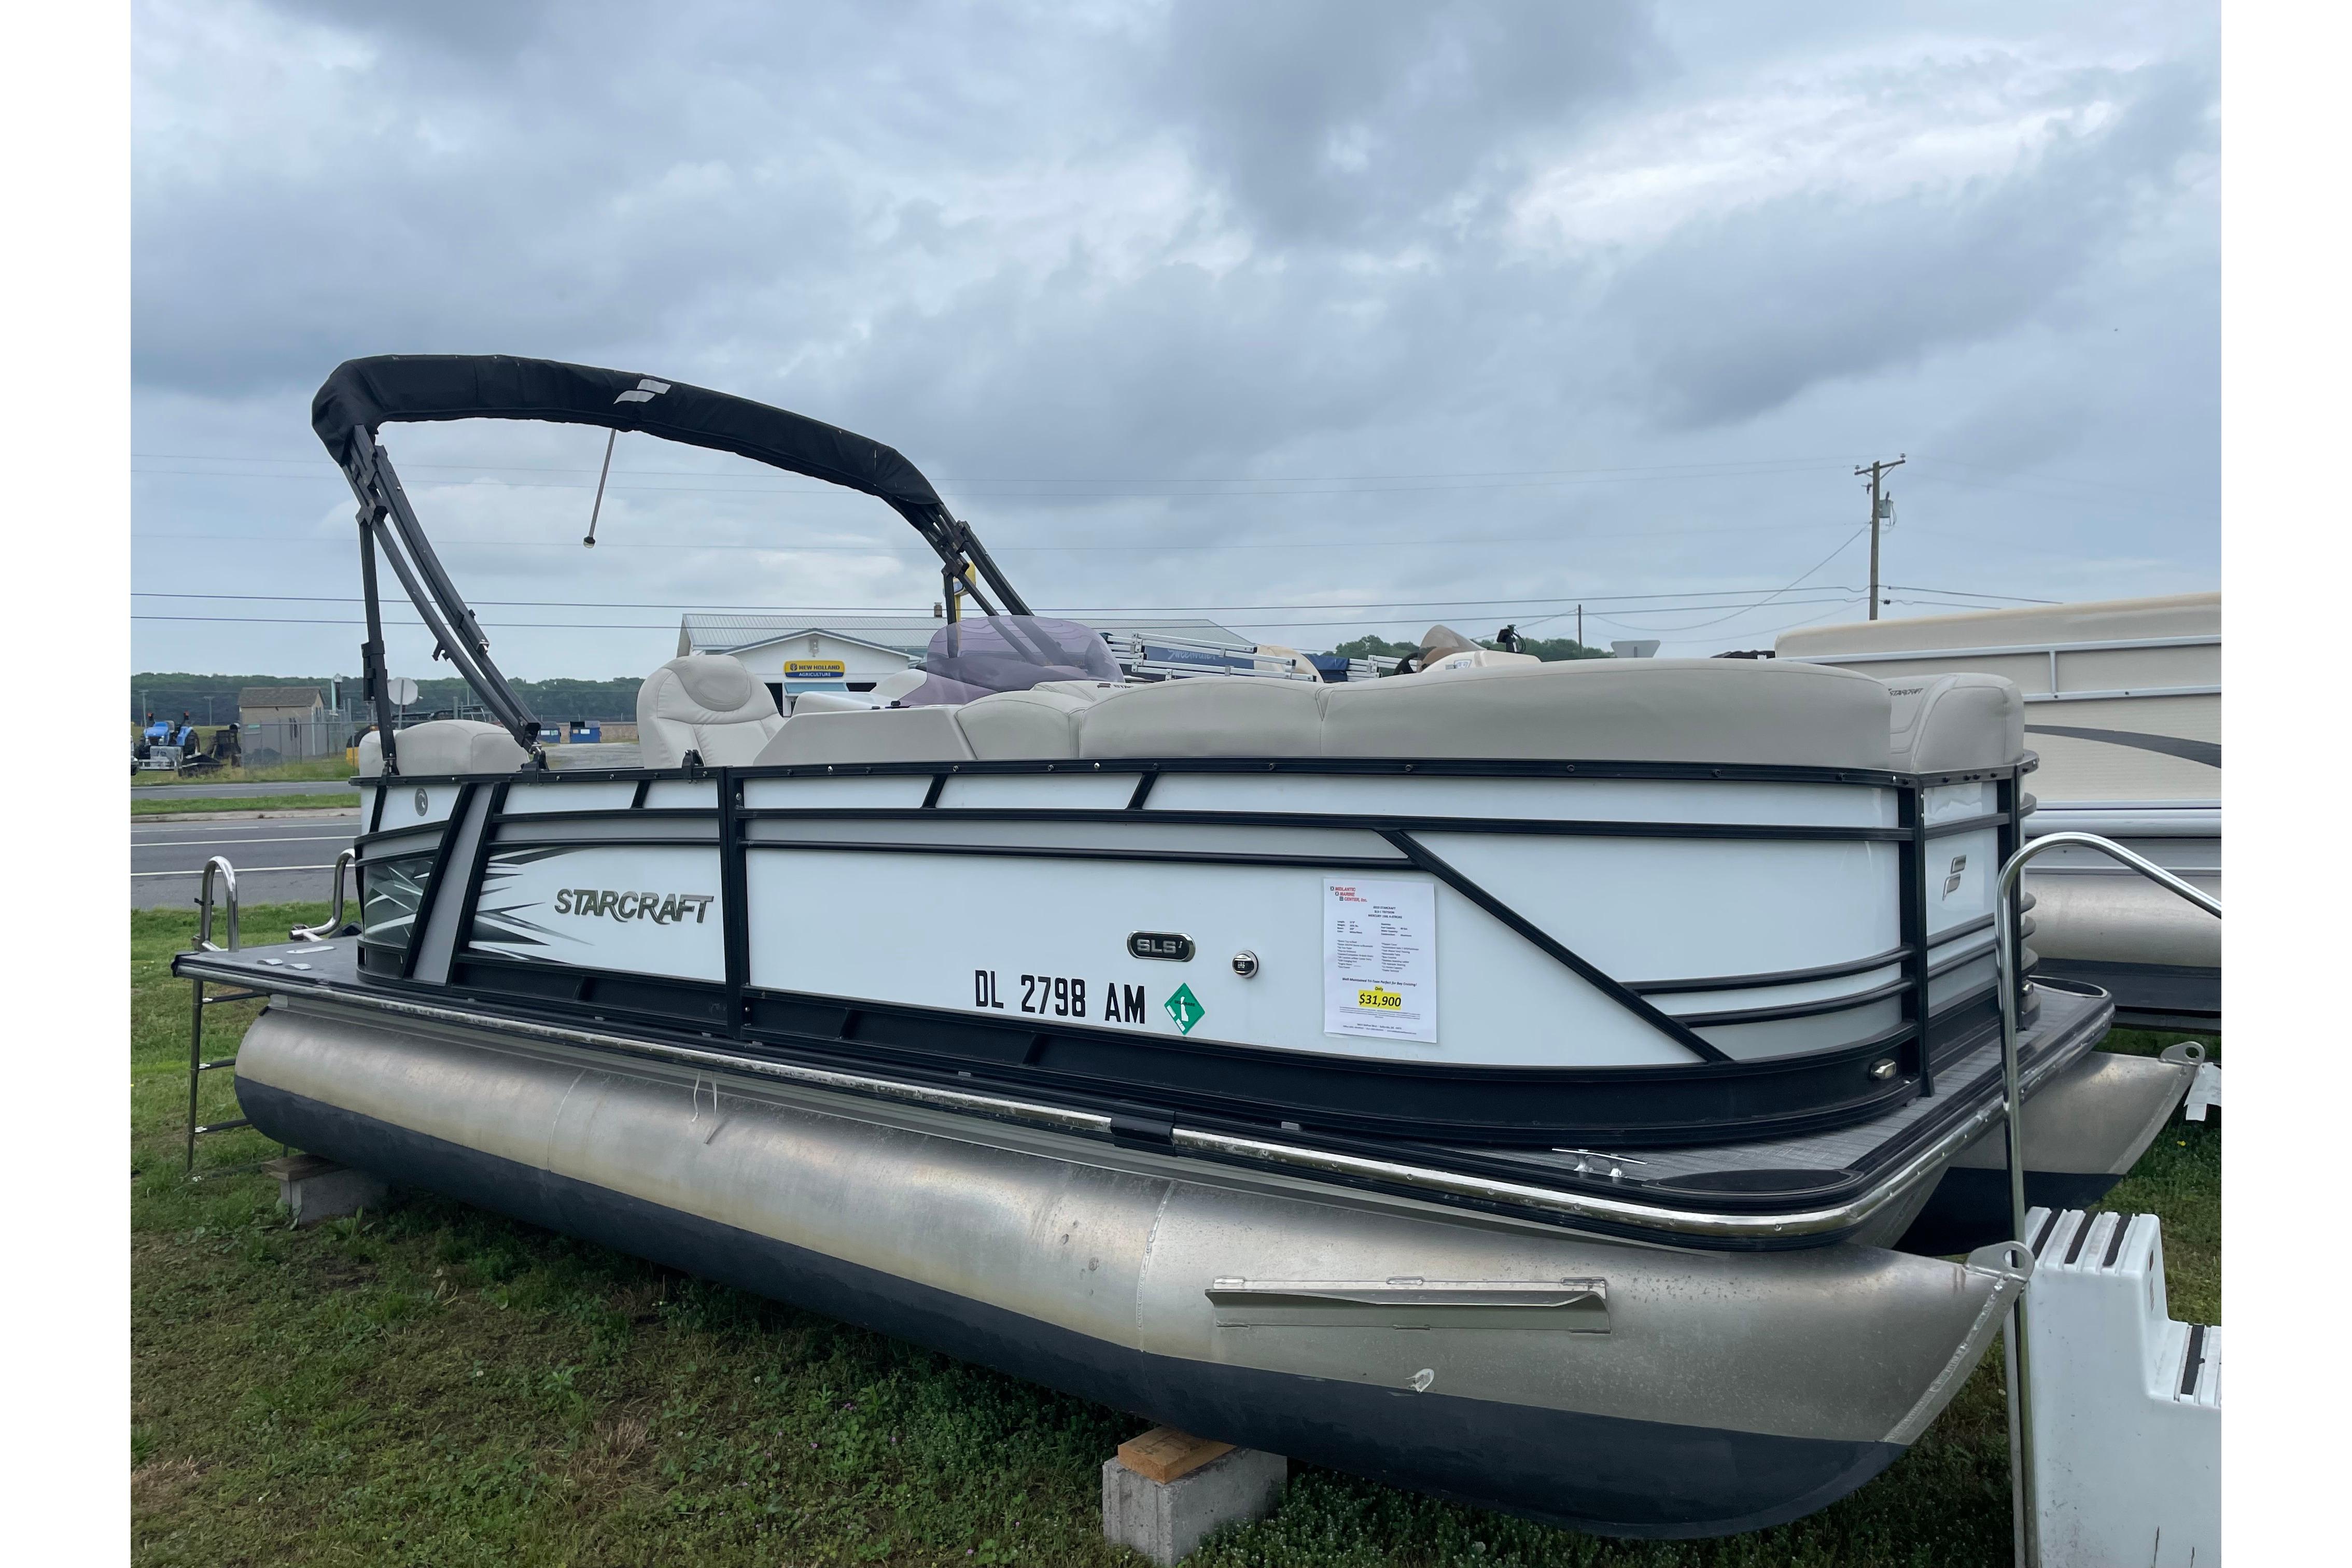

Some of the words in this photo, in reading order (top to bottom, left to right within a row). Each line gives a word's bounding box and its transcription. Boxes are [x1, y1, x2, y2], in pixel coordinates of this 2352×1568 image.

[554, 889, 714, 925] STARCRAFT
[975, 970, 1004, 1009] DL
[1020, 974, 1086, 1017] 2798
[1104, 983, 1145, 1024] AM
[1359, 993, 1401, 1007] $31,900
